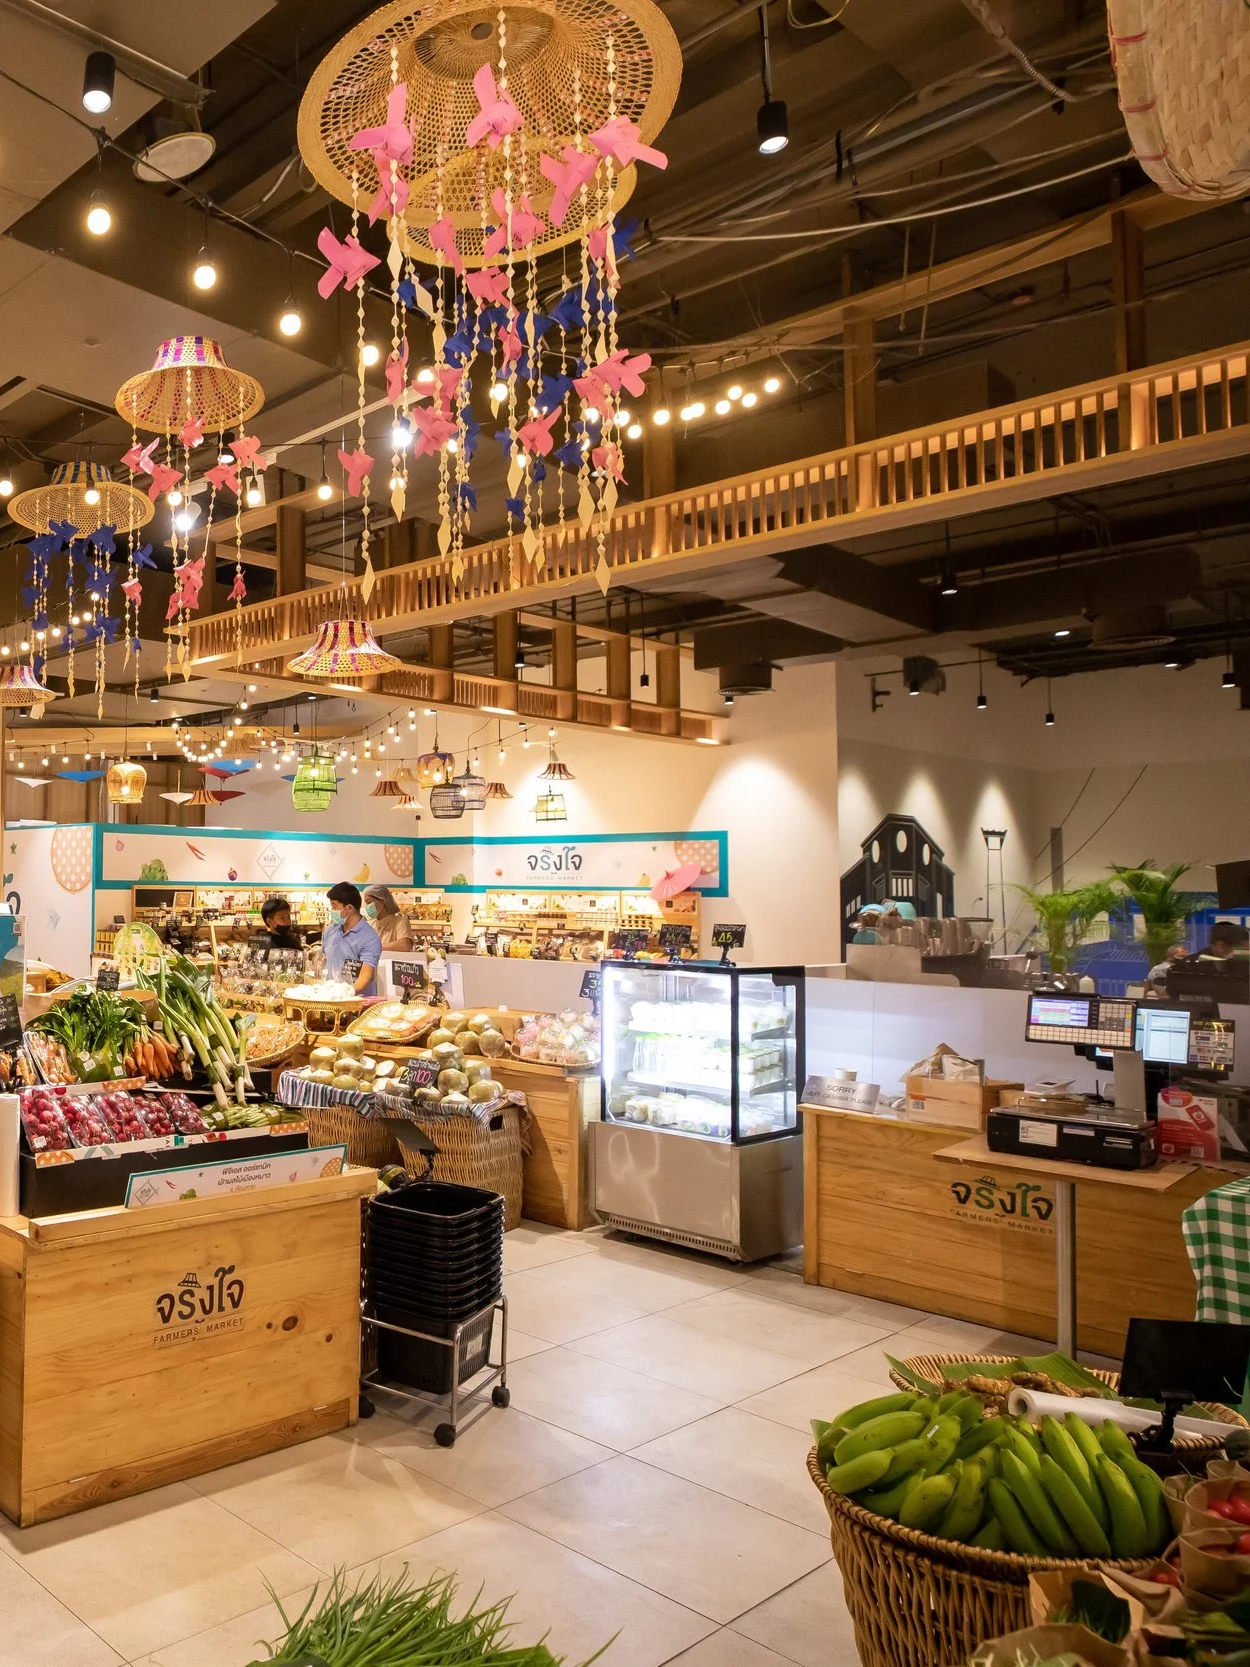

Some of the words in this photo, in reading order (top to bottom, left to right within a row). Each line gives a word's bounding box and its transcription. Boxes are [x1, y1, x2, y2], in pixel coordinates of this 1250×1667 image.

[527, 846, 583, 871] จริงใจ
[826, 1084, 857, 1095] SORRY
[951, 1177, 1054, 1221] จริงใจ
[156, 1264, 245, 1325] จริงใจ
[206, 1317, 244, 1333] MARKET
